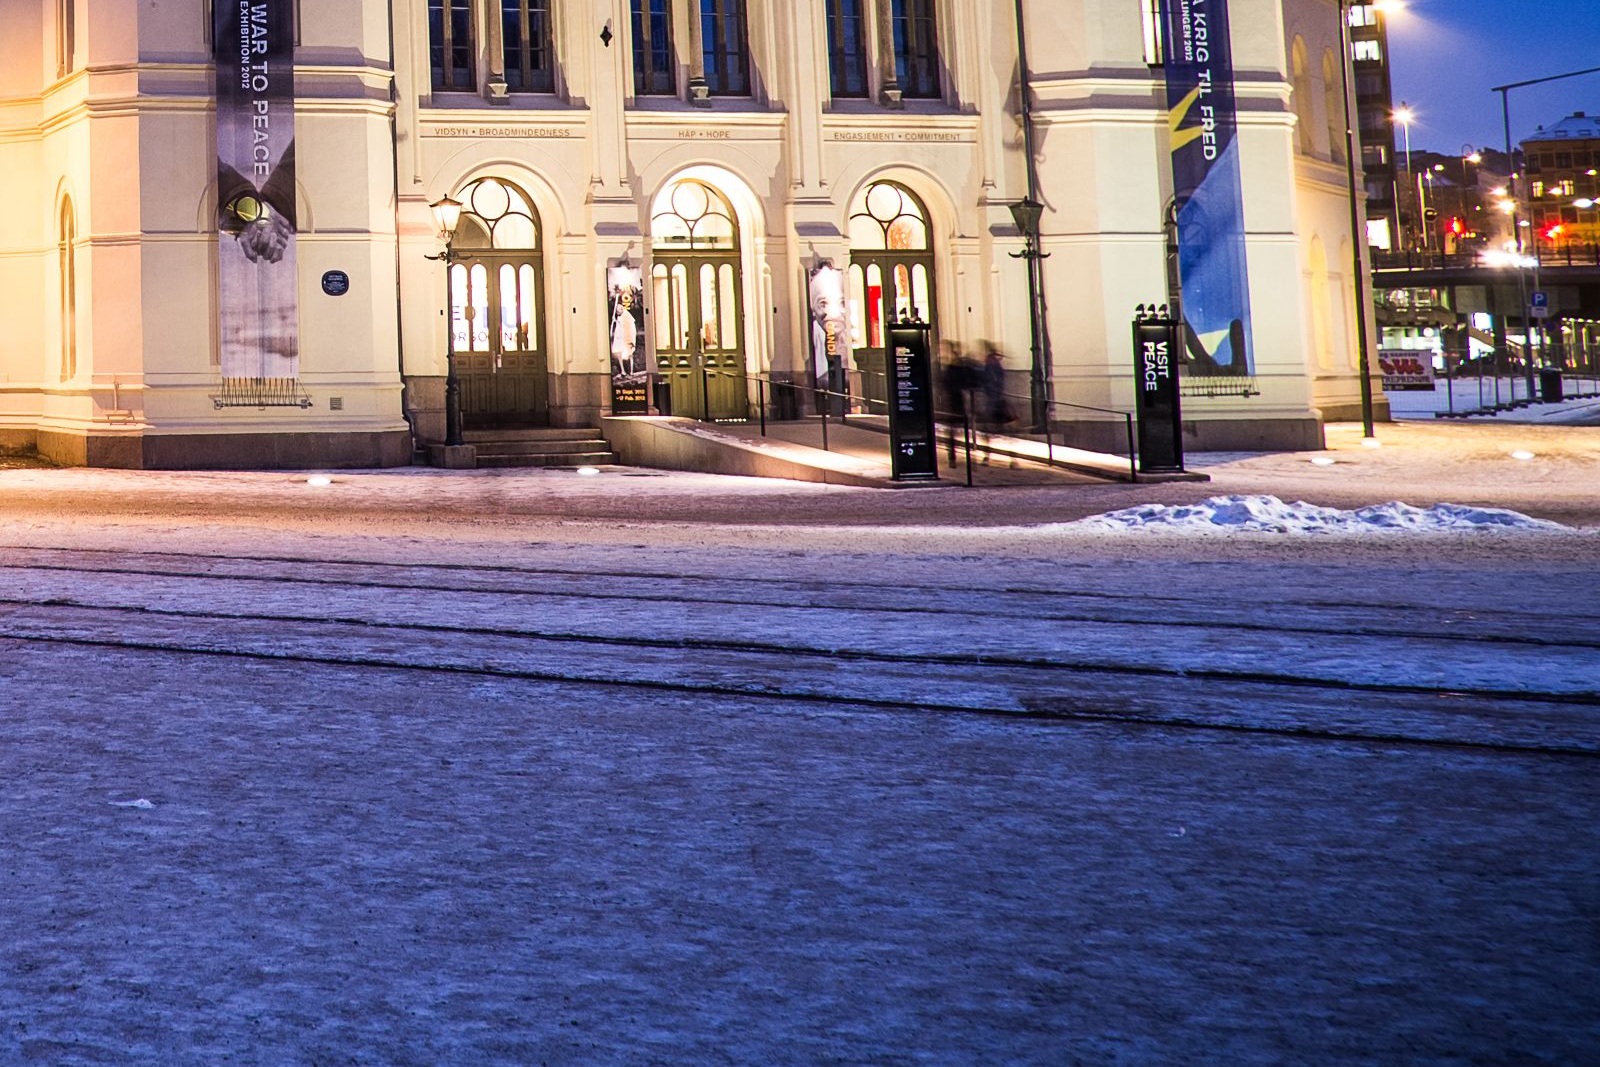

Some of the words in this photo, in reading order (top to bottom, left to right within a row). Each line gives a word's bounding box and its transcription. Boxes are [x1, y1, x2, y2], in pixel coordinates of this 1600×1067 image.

[240, 1, 250, 64] EXHIBITION
[251, 4, 268, 55] WAR
[1193, 13, 1209, 63] KRIG
[1184, 40, 1193, 61] 2012
[241, 66, 250, 89] 2012
[252, 61, 269, 92] TO
[1197, 69, 1212, 99] TIL
[253, 100, 270, 176] PEACE
[434, 127, 469, 136] VIDSYN
[479, 128, 571, 137] BROADMINDEDNESS
[706, 130, 731, 139] HOPE
[834, 132, 895, 141] ENGASJEMENT
[904, 133, 961, 141] COMMITMENT
[1200, 106, 1217, 161] FRED
[1534, 293, 1544, 305] P
[1143, 341, 1157, 391] PEACE
[1156, 341, 1169, 378] VISIT
